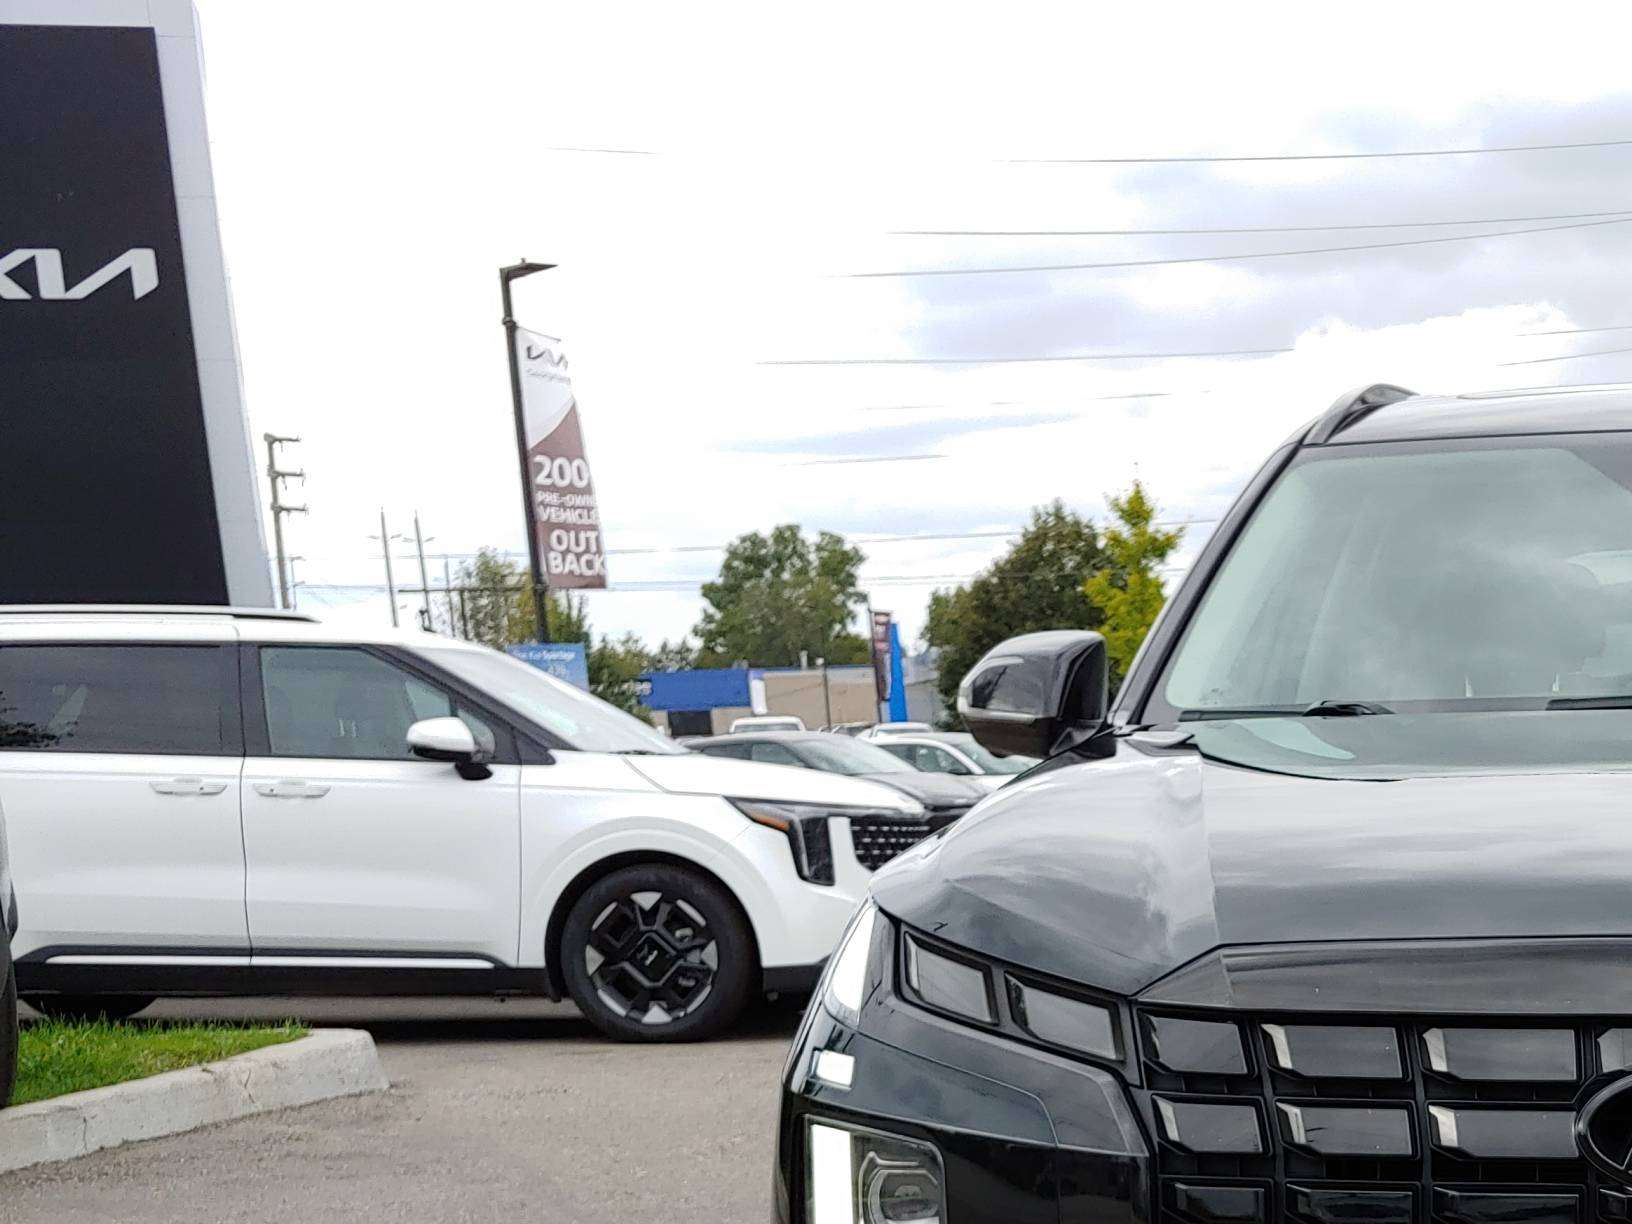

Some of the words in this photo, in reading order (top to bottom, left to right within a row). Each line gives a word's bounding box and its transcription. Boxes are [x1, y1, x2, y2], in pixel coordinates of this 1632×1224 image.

[534, 455, 589, 488] 200
[549, 529, 599, 553] OUT
[547, 551, 605, 576] BACK
